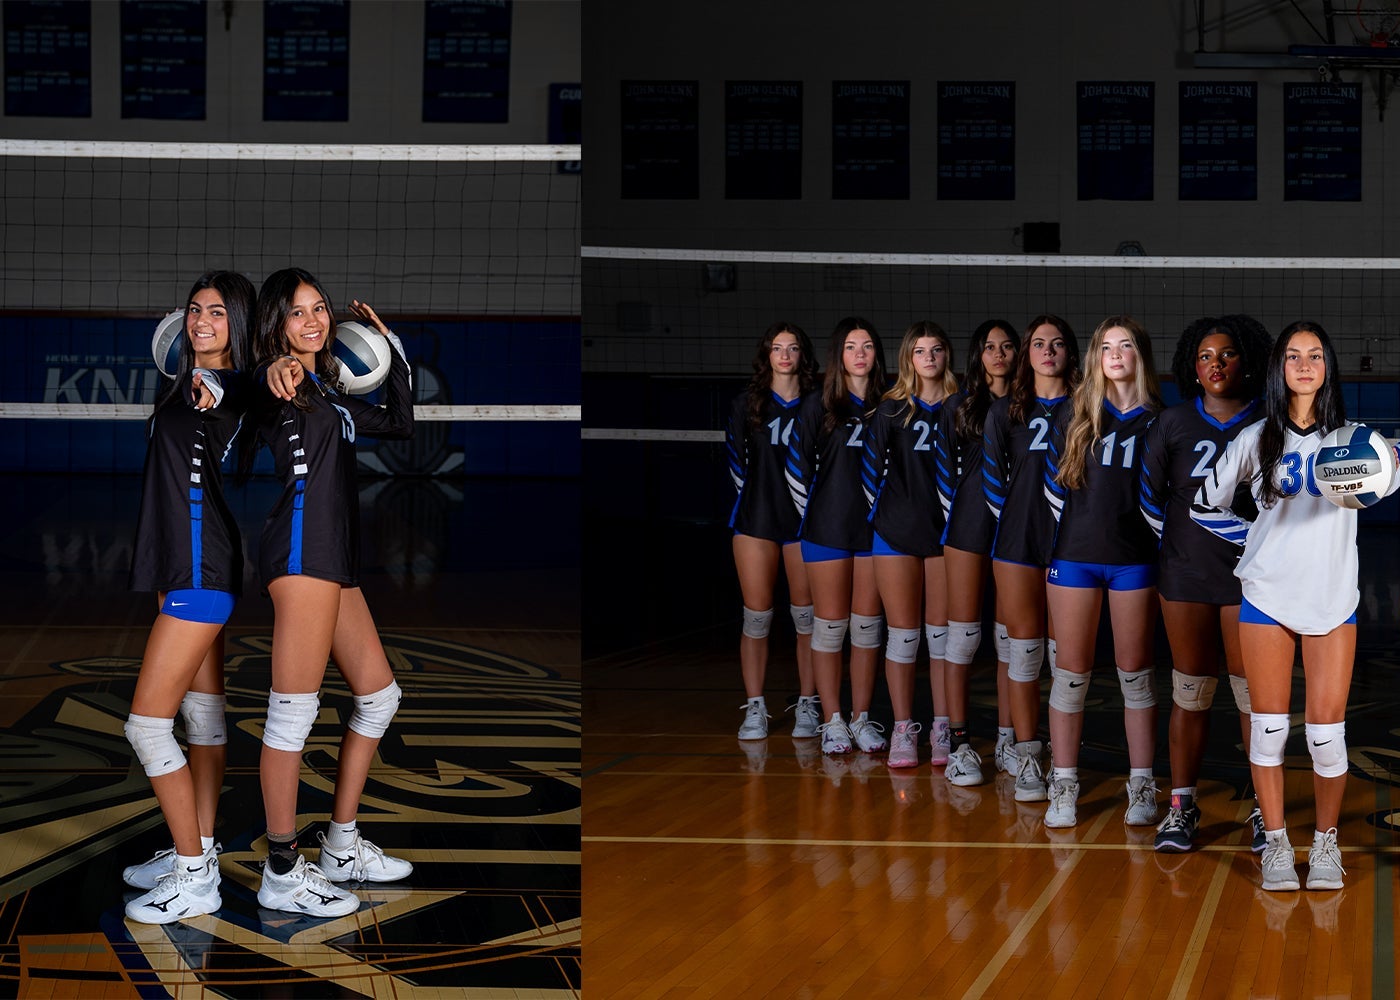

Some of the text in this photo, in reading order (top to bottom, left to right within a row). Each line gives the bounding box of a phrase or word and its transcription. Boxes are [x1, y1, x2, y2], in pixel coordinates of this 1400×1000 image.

[560, 88, 582, 101] GU
[943, 85, 1010, 99] JOHN GLENN
[1081, 86, 1150, 98] JOHN GLENN
[1184, 86, 1253, 98] JOHN GLENN
[1288, 87, 1317, 100] JOHN
[1100, 431, 1137, 468] 11
[1323, 463, 1369, 478] SPALDING
